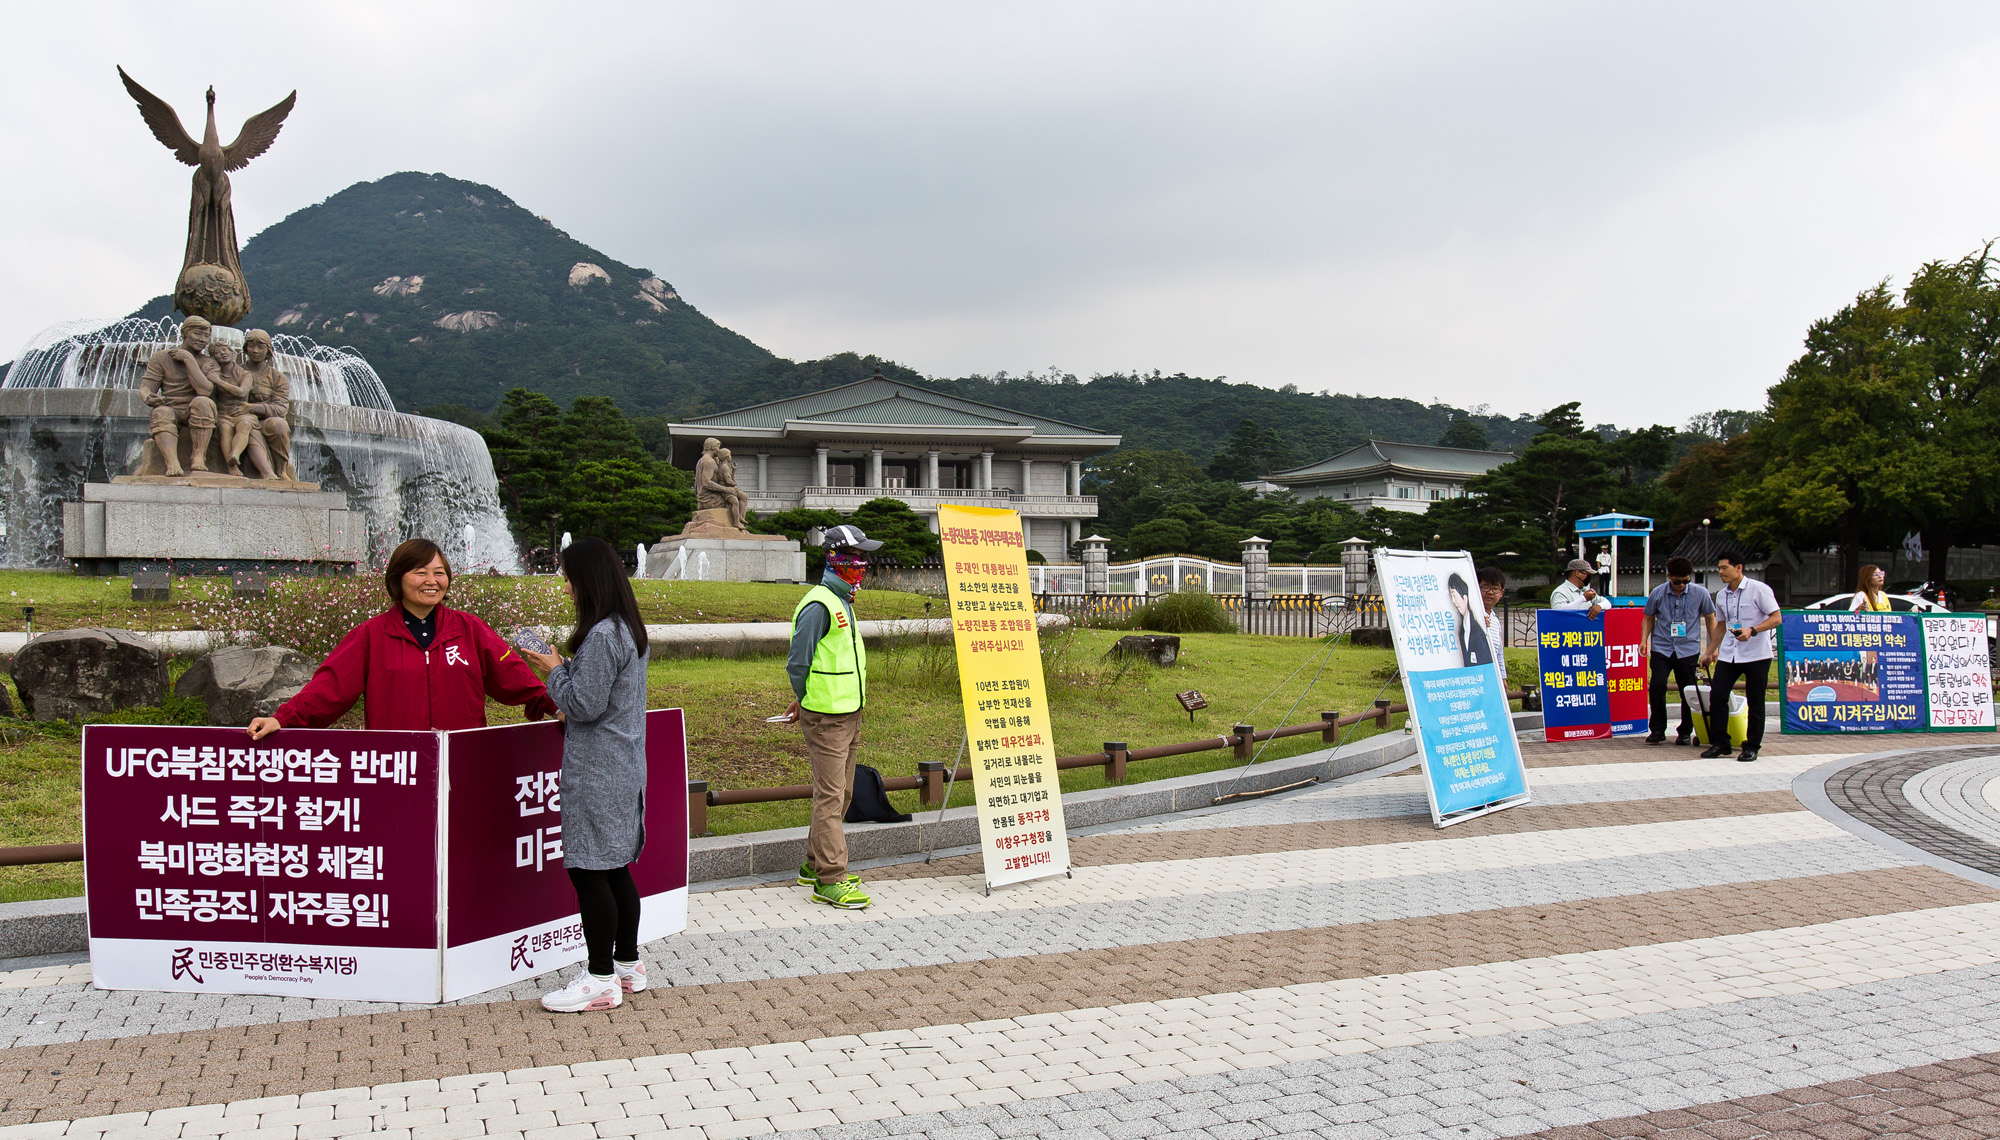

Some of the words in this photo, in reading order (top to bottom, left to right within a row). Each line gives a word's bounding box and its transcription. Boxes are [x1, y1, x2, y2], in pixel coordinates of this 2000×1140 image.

[955, 562, 979, 575] 문재인
[982, 563, 1018, 575] 대통령님!!
[960, 582, 988, 593] 최소한의
[991, 583, 1019, 593] 생존권을
[957, 601, 986, 611] 보장받고
[957, 620, 997, 631] 노량진본동
[1000, 620, 1032, 631] 조합원을
[1950, 619, 1966, 632] 하는
[971, 640, 1024, 652] 살려주십시오!!
[1408, 633, 1458, 655] 석방해주세요
[1541, 632, 1559, 649] 부당
[1563, 633, 1581, 647] 계약
[1584, 631, 1603, 647] 파기
[1803, 634, 1838, 647] 문재인
[1841, 634, 1881, 647] 대통령의
[1884, 634, 1906, 647] 약속!
[445, 645, 469, 666] 民
[1561, 655, 1569, 666] 에
[1572, 655, 1587, 666] 대한
[976, 681, 999, 692] 10년전
[1002, 679, 1029, 690] 조합원이
[1544, 672, 1572, 688] 책임과
[1576, 671, 1604, 687] 배상을
[1607, 679, 1617, 694] 연
[1619, 677, 1643, 692] 회장님!
[1972, 673, 1987, 687] 약속
[978, 699, 1000, 711] 납부한
[1003, 697, 1032, 709] 전재산을
[1556, 694, 1596, 707] 요구합니다!
[1931, 691, 1968, 707] 이행으로
[1973, 692, 1988, 706] 부터
[1798, 705, 1828, 722] 이젠
[1833, 704, 1916, 722] 지켜주십시오!!
[985, 717, 1006, 729] 악법을
[1009, 716, 1030, 726] 이용해
[977, 739, 999, 751] 탈취한
[1001, 734, 1045, 748] 대우건설과,
[983, 757, 1012, 770] 길거리로
[1014, 754, 1042, 766] 내몰리는
[1461, 752, 1473, 765] 동생
[105, 747, 342, 784] UFG북침전쟁연습
[350, 750, 417, 787] 반대!
[990, 775, 1011, 788] 서민의
[1014, 772, 1042, 785] 피눈물을
[989, 794, 1018, 808] 외면하고
[1020, 790, 1048, 803] 대기업과
[160, 795, 219, 829] 사드
[228, 796, 286, 831] 즉각
[295, 798, 360, 833] 철거!
[993, 815, 1015, 828] 한몸된
[1017, 809, 1050, 825] 동작구청
[996, 831, 1052, 850] 이창우구청장을
[138, 840, 309, 878] 북미평화협정
[317, 843, 384, 881] 체결!
[1005, 851, 1050, 871] 고발합니다!!
[136, 888, 258, 925] 민족공조!
[268, 891, 389, 928] 자주통일!
[511, 934, 534, 971] 民
[171, 947, 204, 985] 民
[200, 951, 358, 974] 민중민주당(환수복지당)
[244, 973, 268, 983] People's
[269, 974, 299, 984] Democracy
[300, 976, 314, 985] Party
